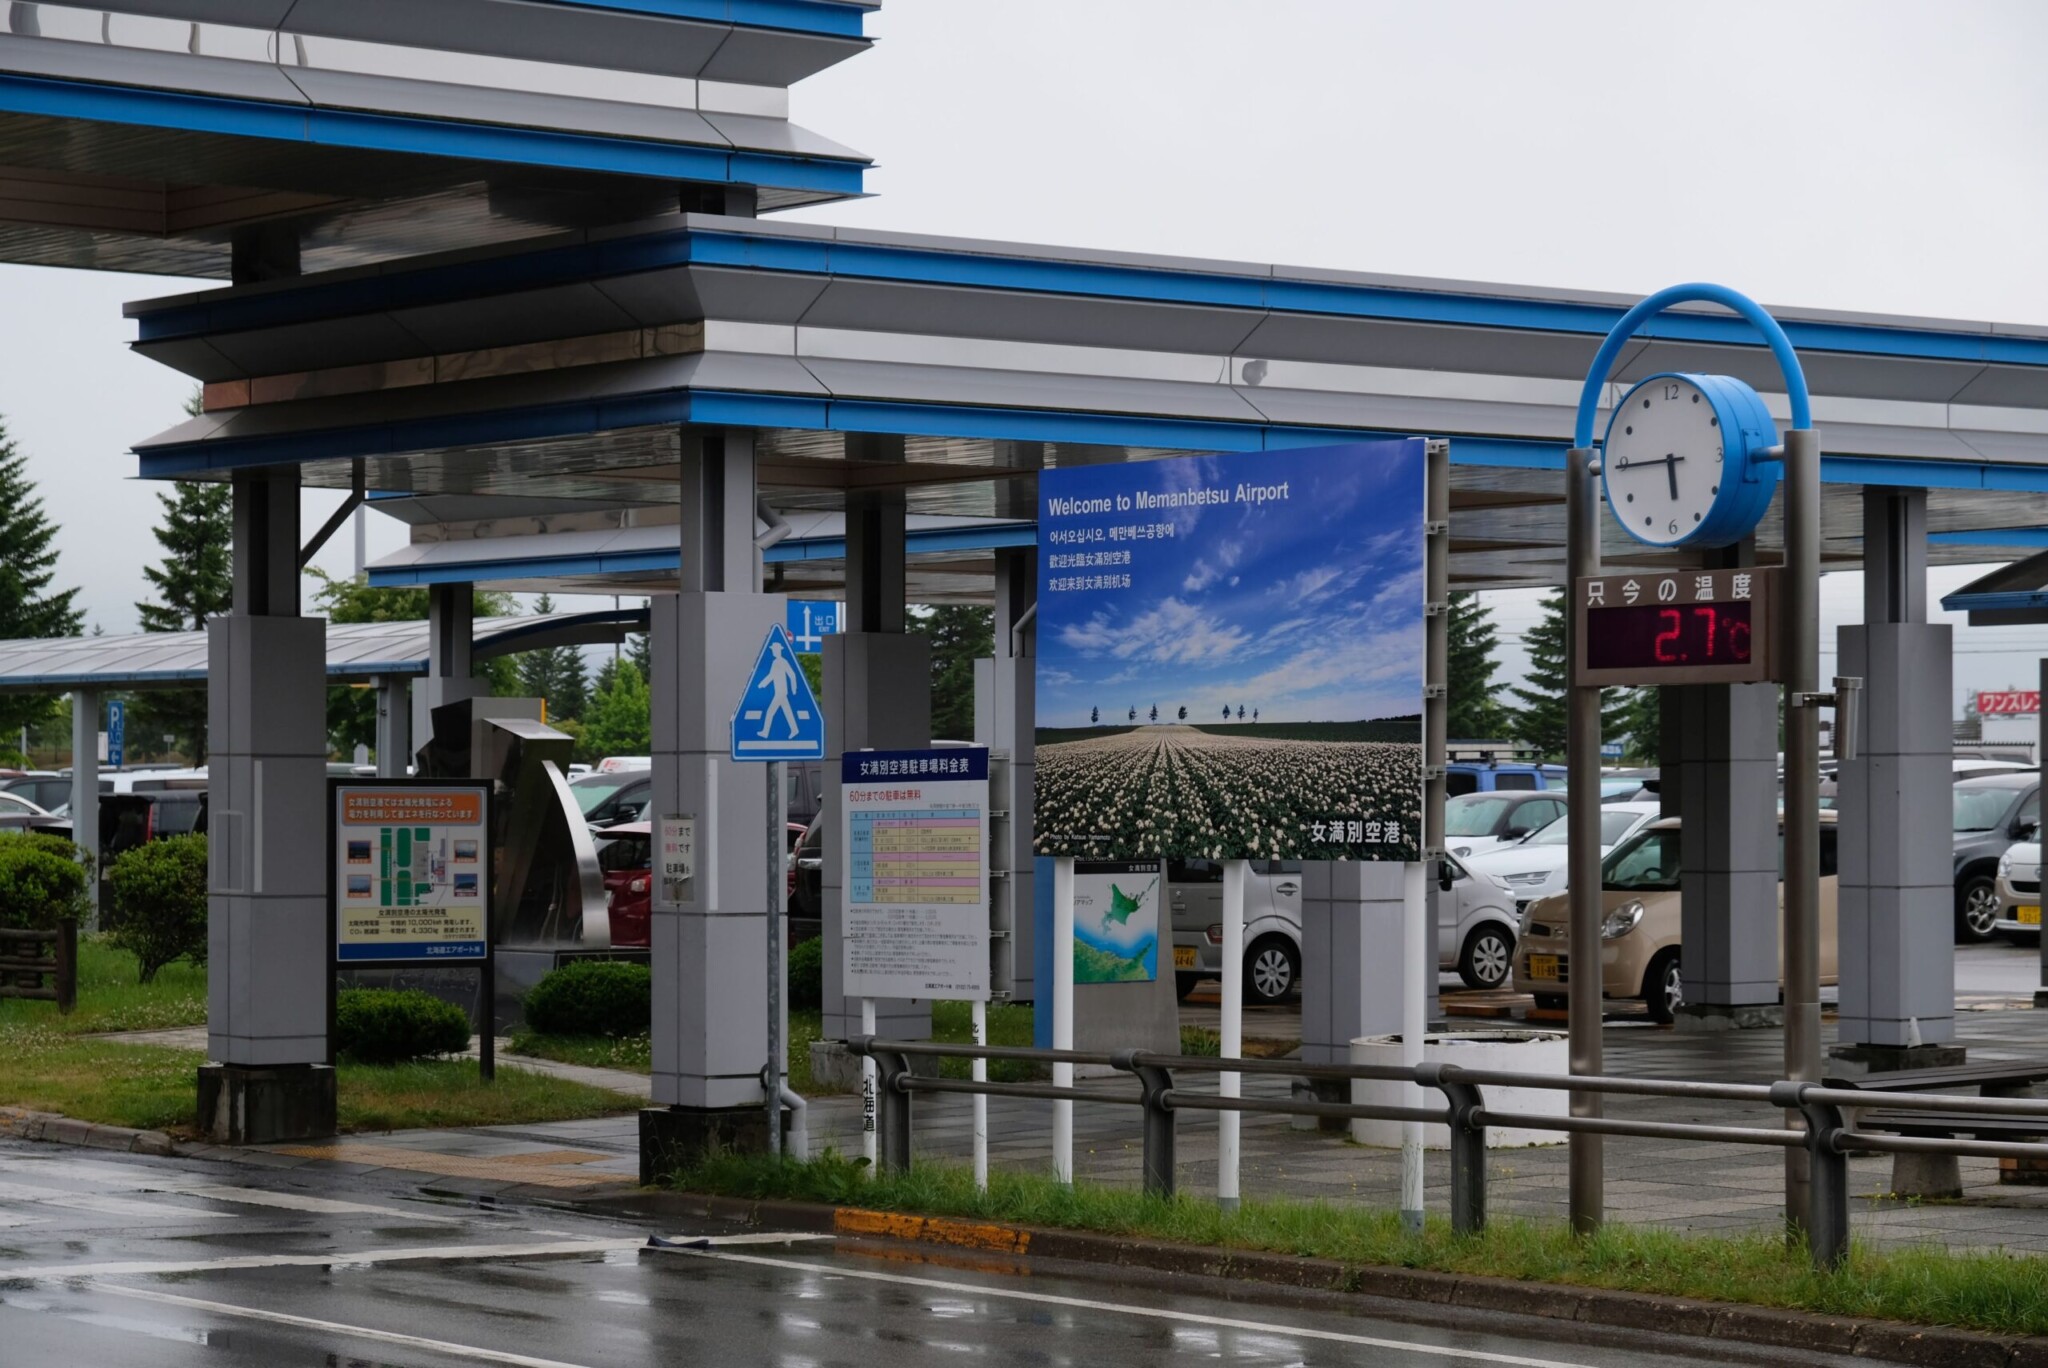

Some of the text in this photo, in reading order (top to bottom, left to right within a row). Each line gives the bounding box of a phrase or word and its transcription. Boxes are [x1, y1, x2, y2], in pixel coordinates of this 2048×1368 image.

[1664, 384, 1679, 401] 12
[1715, 447, 1723, 463] 3
[1048, 481, 1289, 516] Welcome to Memanbetsu Airport
[1668, 519, 1678, 535] 6
[1050, 528, 1106, 545] 어서오십시오,
[1587, 573, 1752, 606] 只今の温度
[815, 615, 834, 626] 出口
[860, 758, 969, 776] 女満別空港駐車場料金表
[849, 789, 921, 802] 60分までの駐車は無料
[1310, 819, 1400, 844] 女満別空港
